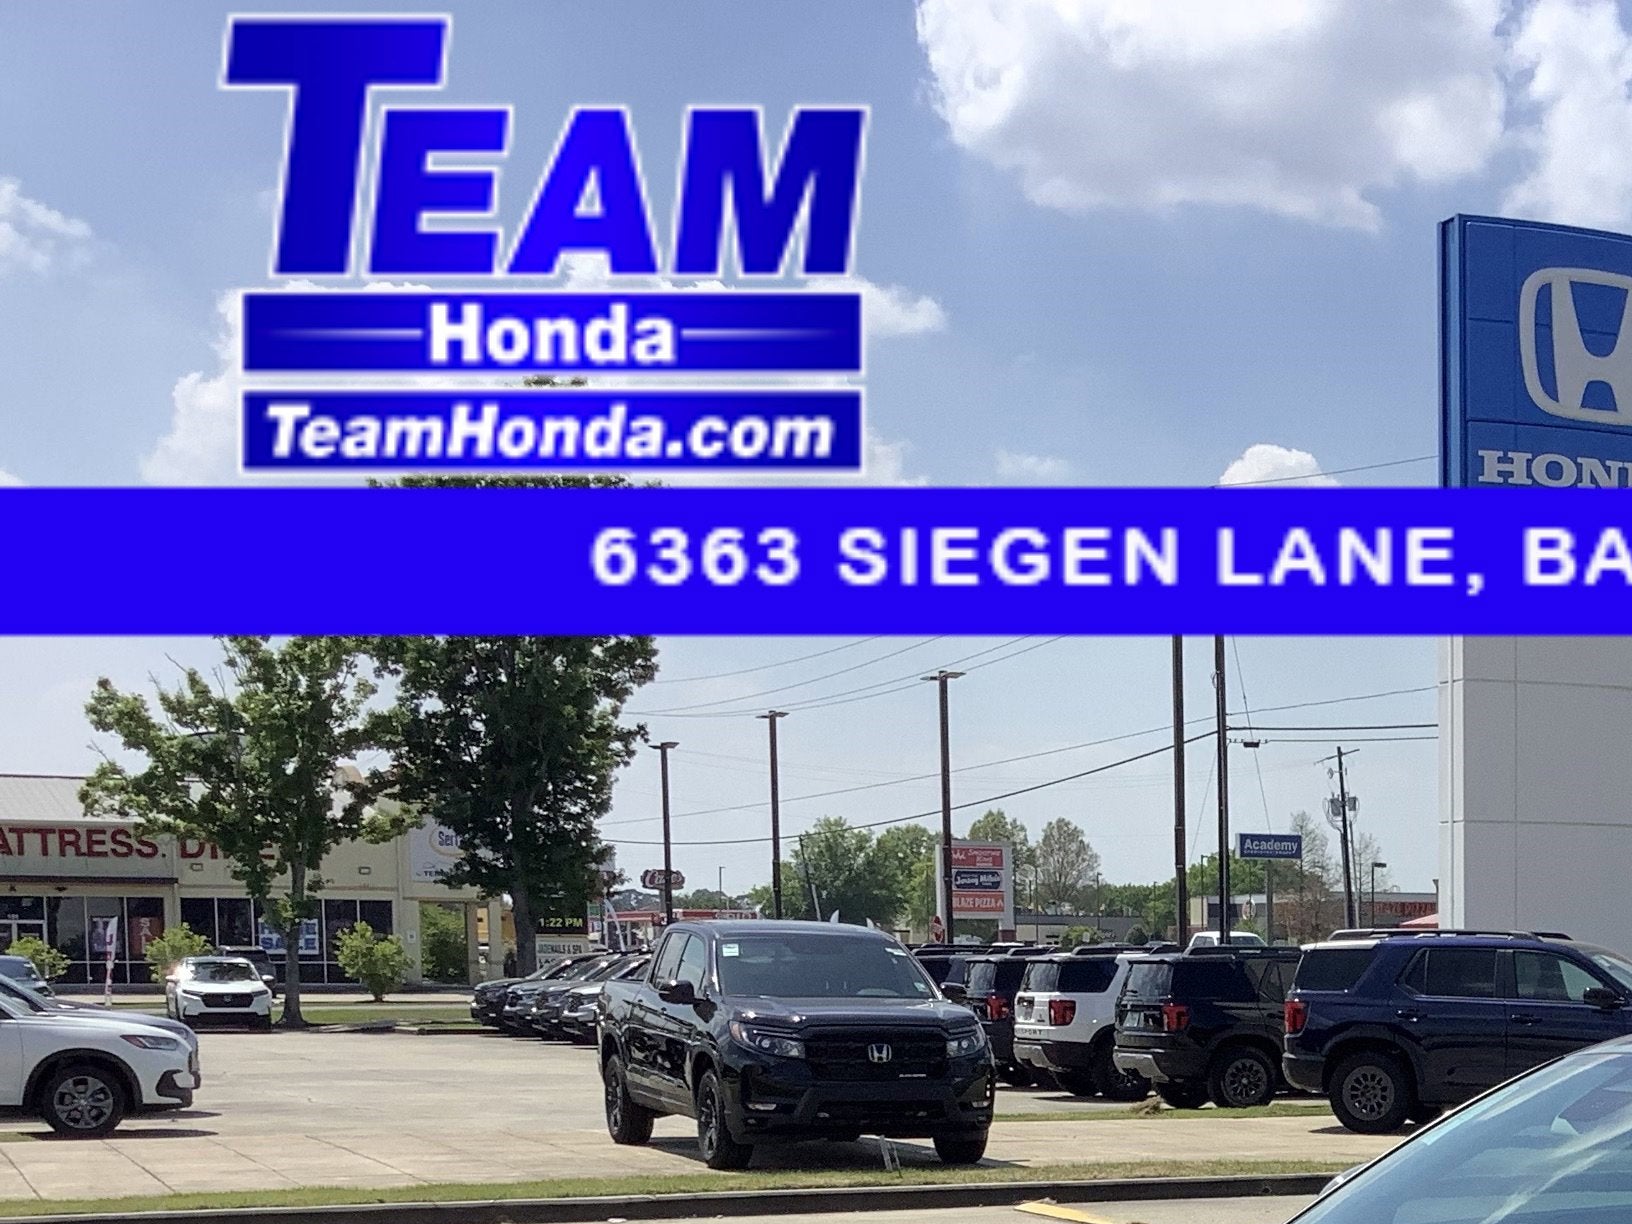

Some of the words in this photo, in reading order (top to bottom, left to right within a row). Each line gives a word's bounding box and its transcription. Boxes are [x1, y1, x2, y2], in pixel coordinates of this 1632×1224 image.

[1243, 838, 1298, 854] Academy
[539, 918, 563, 927] 1:22
[565, 918, 583, 927] PM
